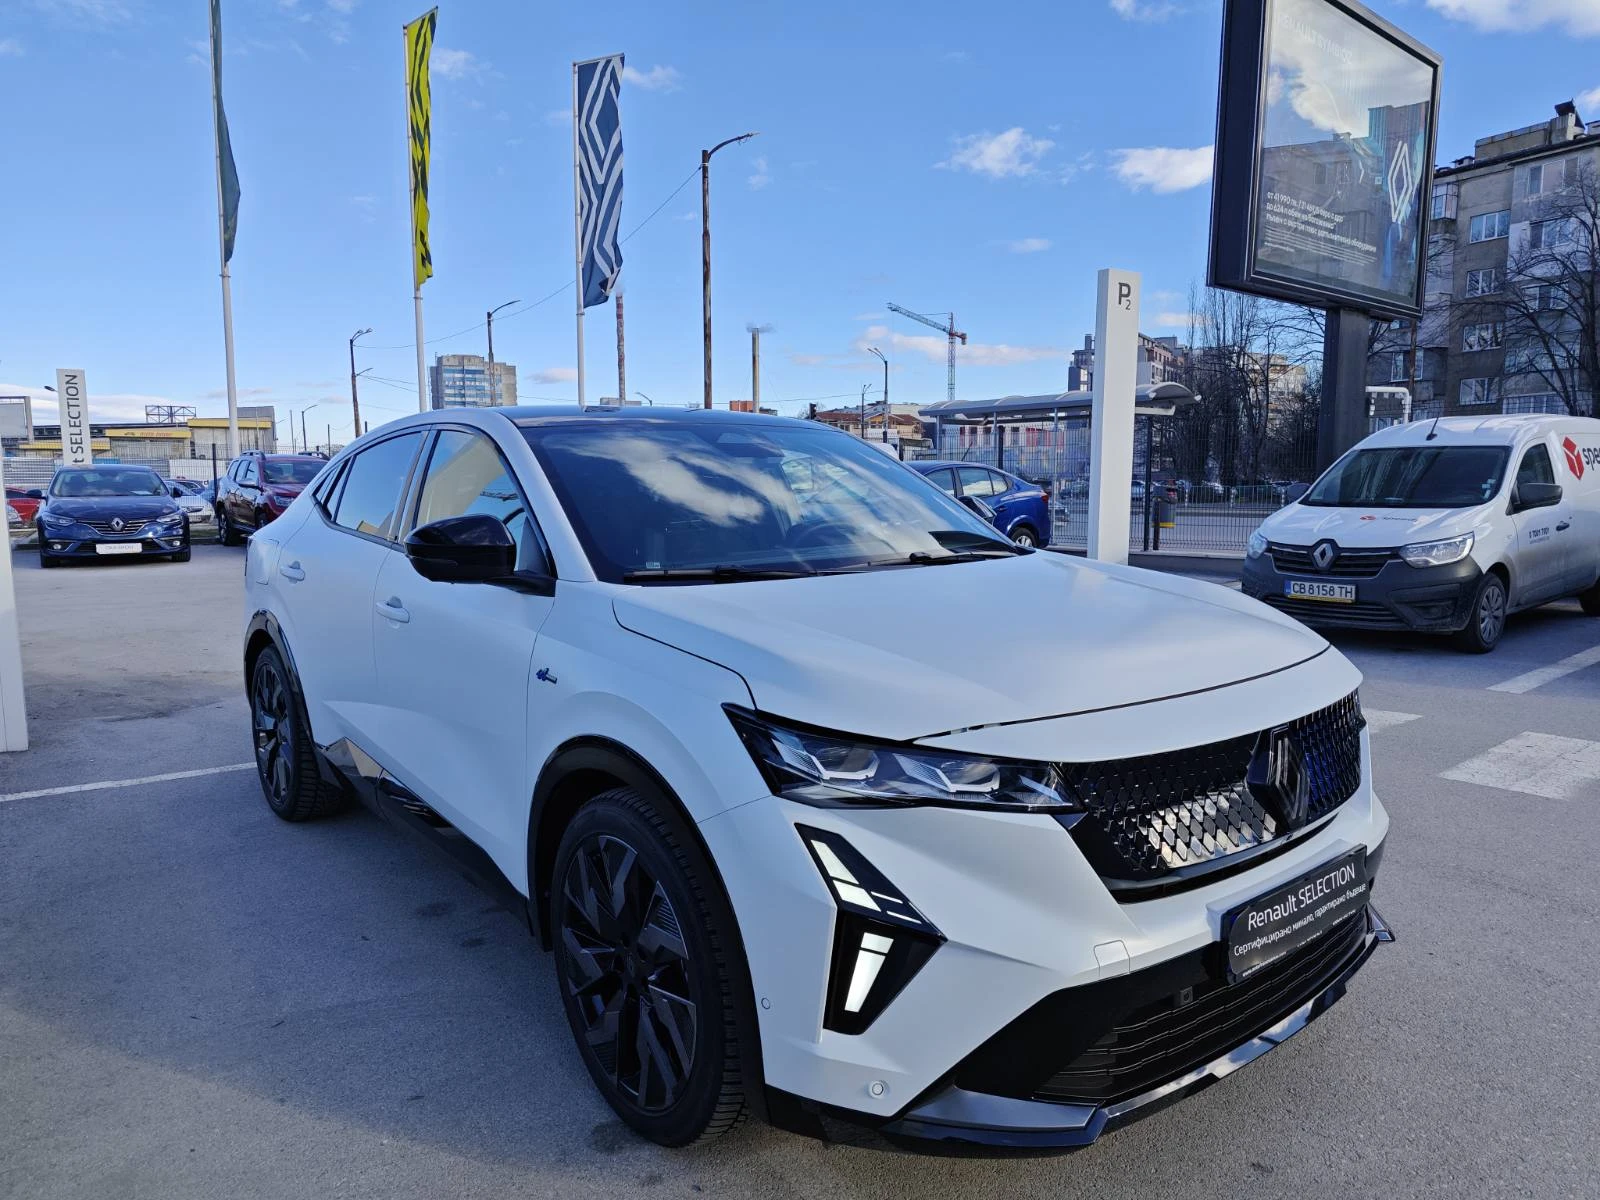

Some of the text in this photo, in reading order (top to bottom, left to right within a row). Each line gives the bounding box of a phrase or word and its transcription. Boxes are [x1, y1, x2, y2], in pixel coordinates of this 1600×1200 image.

[65, 374, 83, 454] SELECTION
[1582, 447, 1600, 471] spe
[1292, 583, 1353, 598] CB 8158 TH
[1248, 894, 1297, 931] Renault
[1298, 863, 1355, 909] SELECTION
[1234, 925, 1292, 956] Сертифицирано
